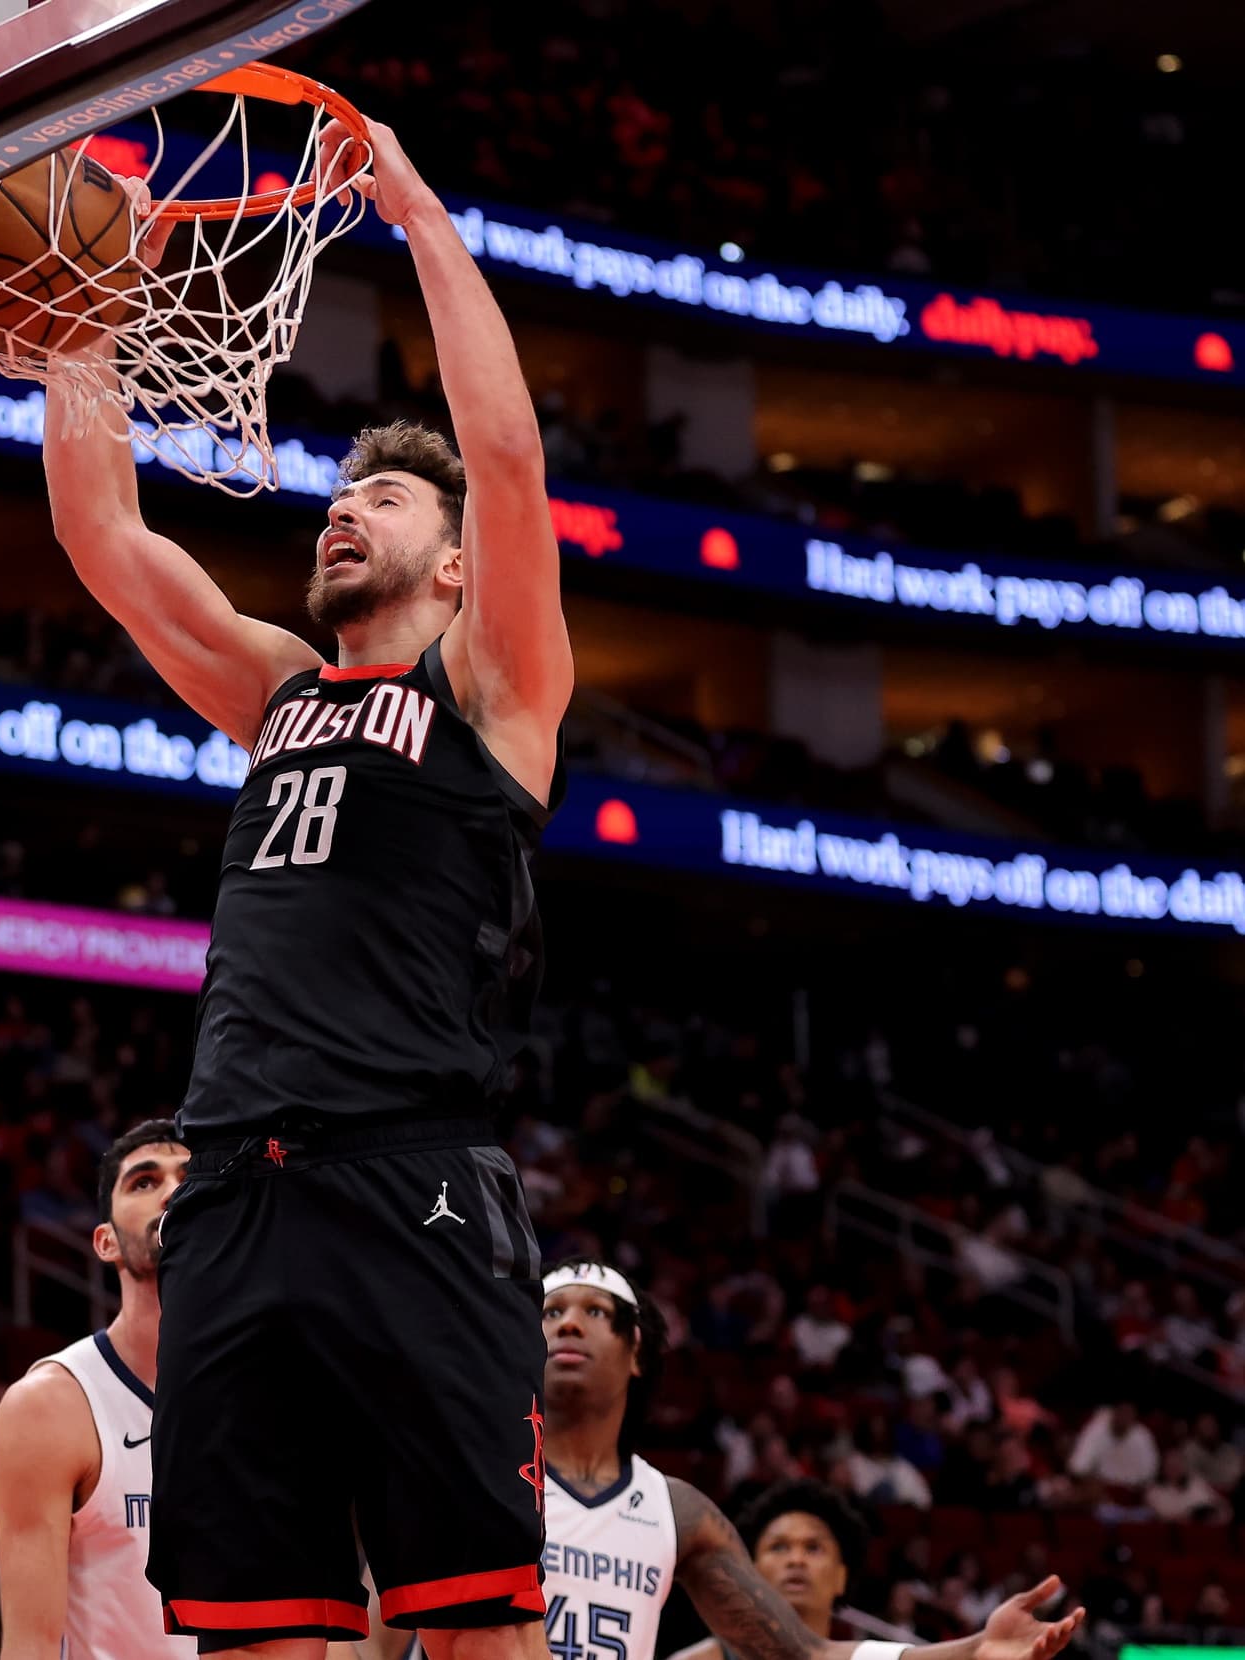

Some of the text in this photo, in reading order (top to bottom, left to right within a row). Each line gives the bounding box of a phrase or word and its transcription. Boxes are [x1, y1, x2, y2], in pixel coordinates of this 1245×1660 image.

[22, 57, 222, 143] veraclinic.net
[484, 220, 574, 277] work
[572, 242, 654, 297] pays
[654, 253, 705, 305] off
[703, 271, 752, 316] on
[749, 273, 812, 325] the
[806, 539, 895, 603] Hard
[894, 562, 995, 615] work
[995, 575, 1088, 629] pays
[1087, 575, 1145, 629] off
[1143, 589, 1199, 634] on
[59, 719, 123, 771] on
[122, 718, 196, 781] the
[247, 683, 435, 775] HOUSTON
[249, 766, 347, 870] 28
[721, 809, 1245, 935] Hard work pays off on the dail
[542, 1541, 661, 1597] EMPHIS
[544, 1594, 632, 1660] 45
